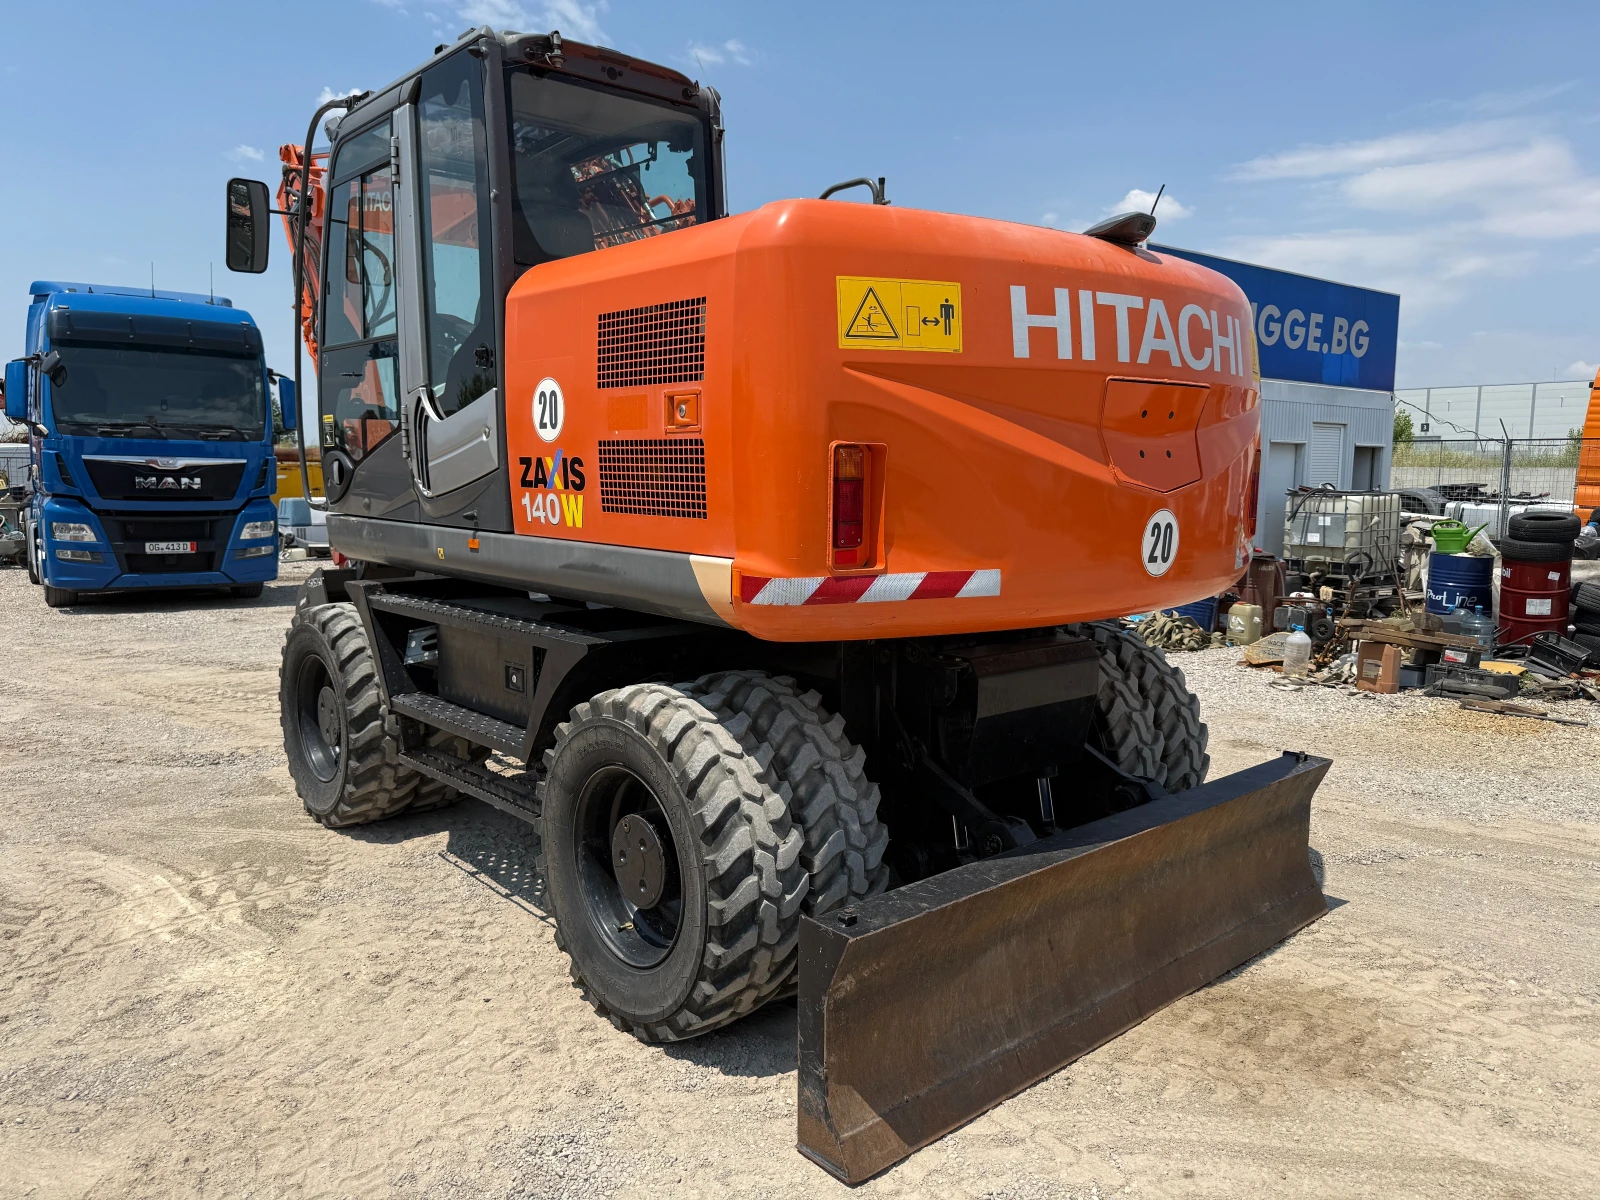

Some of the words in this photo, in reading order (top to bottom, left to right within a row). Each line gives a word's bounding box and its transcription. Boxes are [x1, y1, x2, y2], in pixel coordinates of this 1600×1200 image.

[1009, 285, 1244, 377] HITACHI
[538, 390, 558, 430] 20
[135, 476, 202, 490] MAN
[519, 449, 586, 492] ZAXIS
[521, 492, 584, 529] 140W
[1147, 522, 1173, 563] 20
